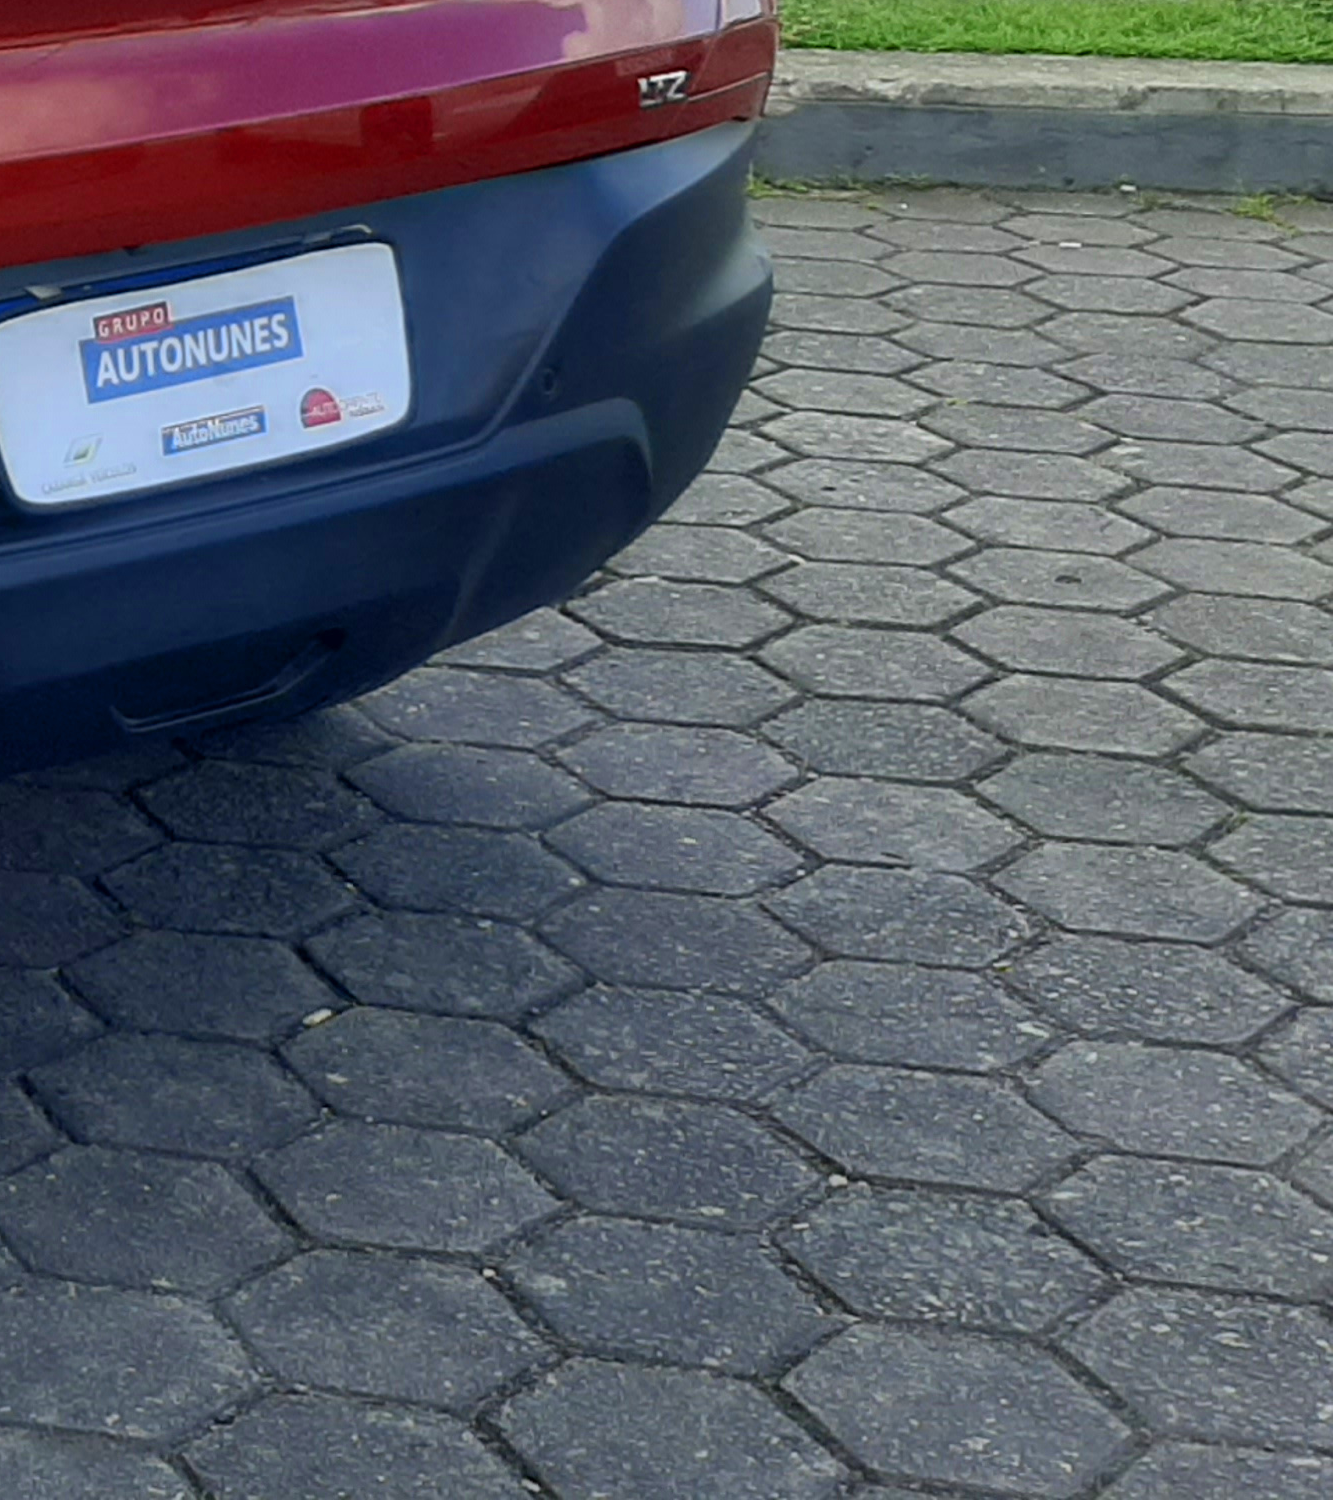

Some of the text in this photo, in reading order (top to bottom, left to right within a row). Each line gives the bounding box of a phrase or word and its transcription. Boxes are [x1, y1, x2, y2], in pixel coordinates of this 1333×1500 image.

[636, 69, 689, 108] LTZ
[96, 307, 167, 339] GRUPO
[95, 312, 290, 389] AUTONUNES
